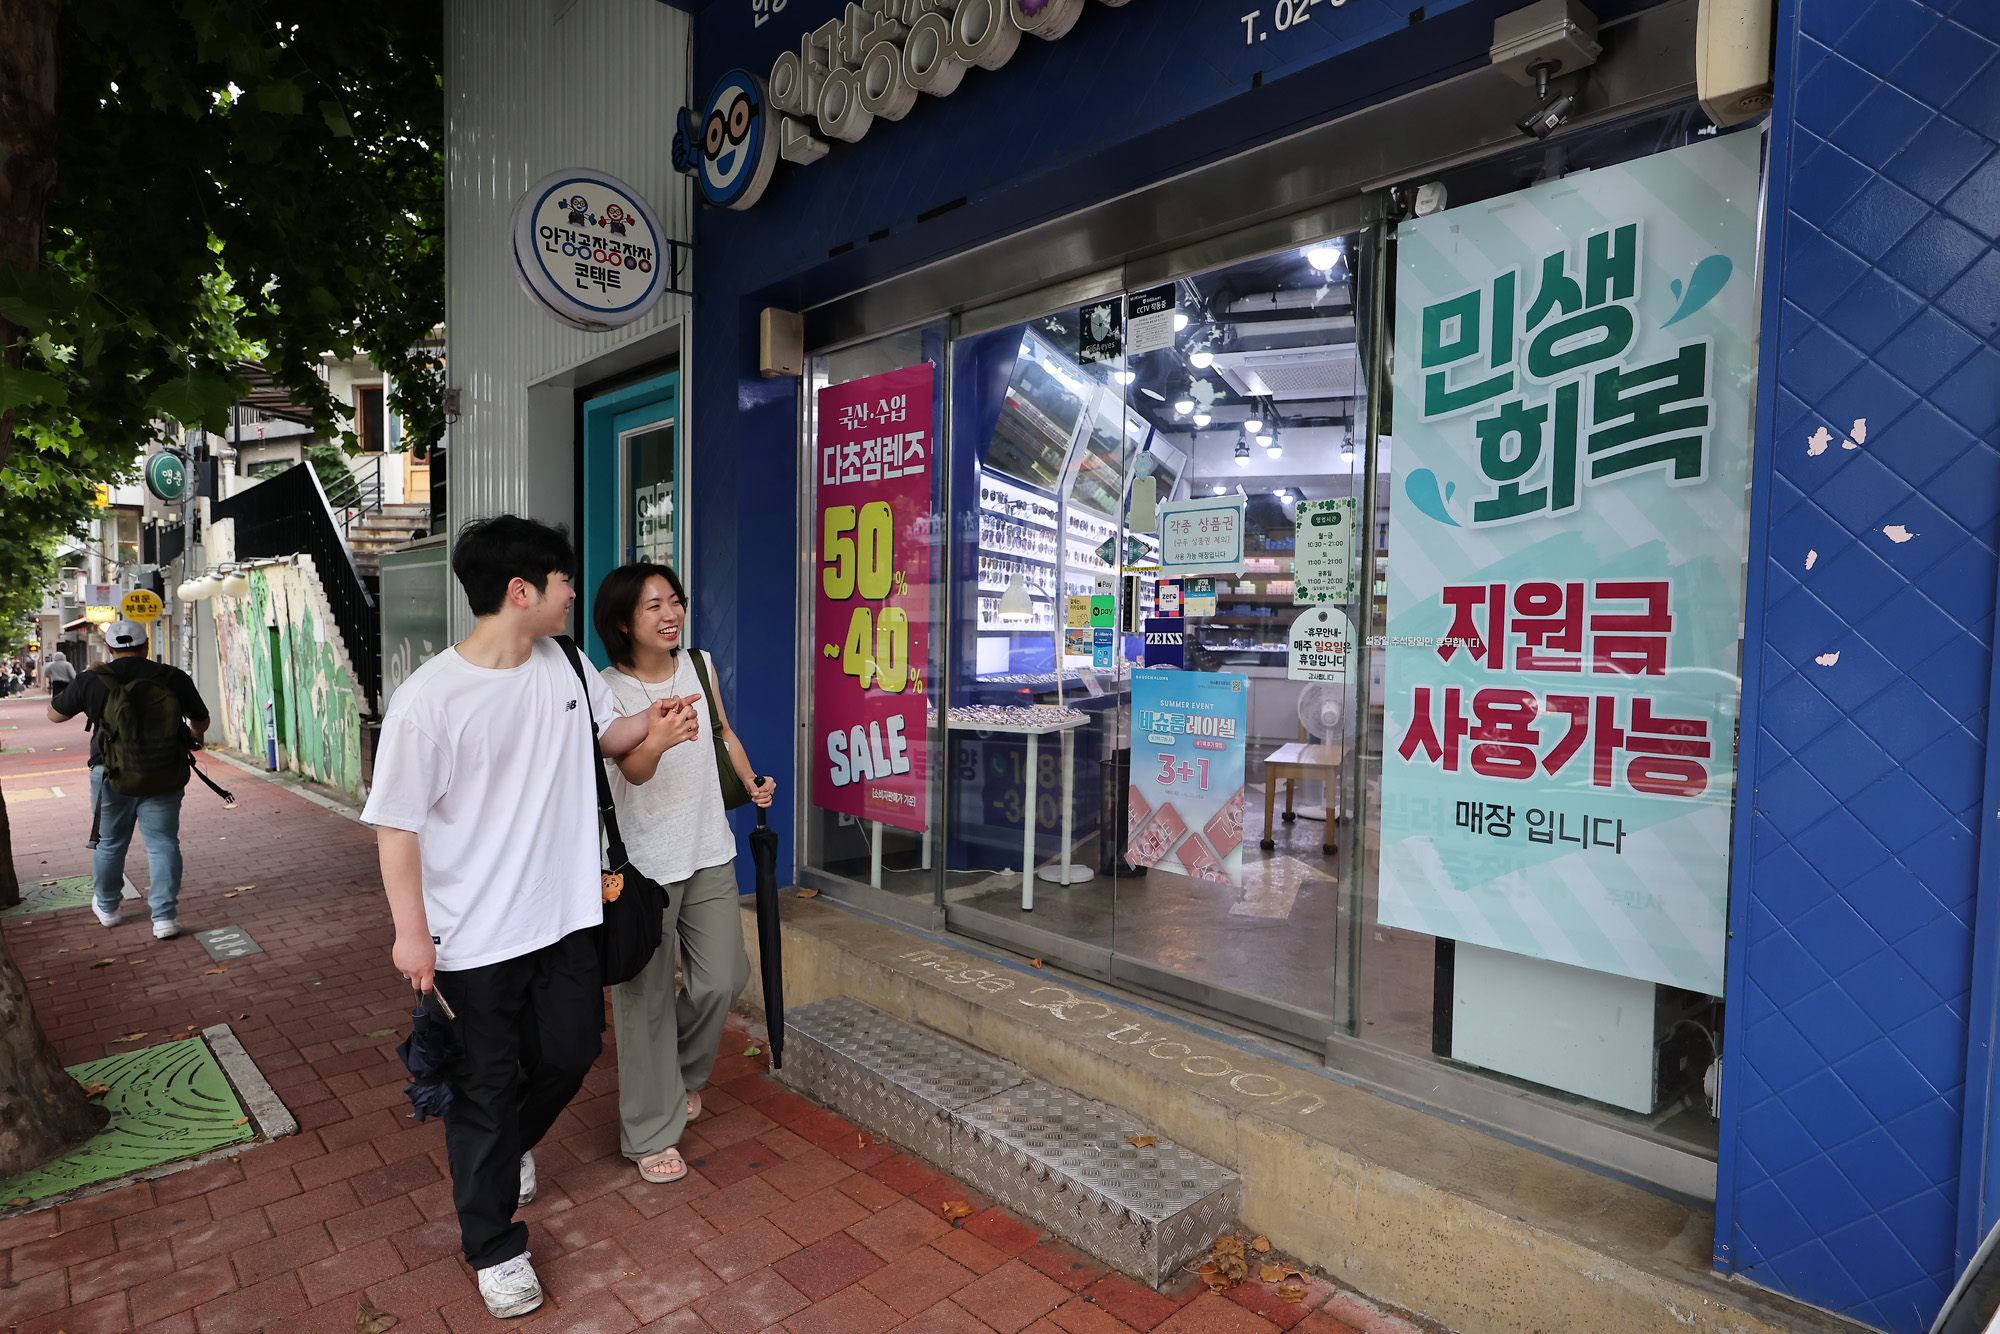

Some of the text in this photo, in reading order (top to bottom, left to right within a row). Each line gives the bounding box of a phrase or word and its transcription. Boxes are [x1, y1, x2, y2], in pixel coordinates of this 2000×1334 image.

[1241, 10, 1266, 45] T.
[540, 226, 652, 273] 안경공장공장장
[575, 262, 621, 293] 콘택트
[1137, 305, 1150, 314] CCTV
[1421, 223, 1637, 417] 민생
[1473, 343, 1709, 522] 회복
[823, 430, 926, 486] 다초점렌즈
[1170, 515, 1234, 534] 각종 상품권
[823, 501, 908, 600] 50%
[1192, 537, 1211, 546] 상품권
[1103, 581, 1112, 589] Pay
[125, 604, 157, 613] 부동산
[130, 594, 151, 603] 대운
[1101, 608, 1113, 616] pay
[1146, 632, 1183, 645] ZEISS
[1437, 581, 1672, 675] 지원금
[1294, 640, 1352, 654] 매주 일요일은
[1436, 637, 1480, 648] 휴무합니다
[1299, 654, 1345, 667] 휴일입니다
[1160, 700, 1214, 710] SUMMER EVENT
[827, 713, 911, 788] SALE
[1398, 688, 1711, 797] 사용가능
[1156, 753, 1209, 790] 3+1
[1456, 801, 1626, 854] 매장 입니다
